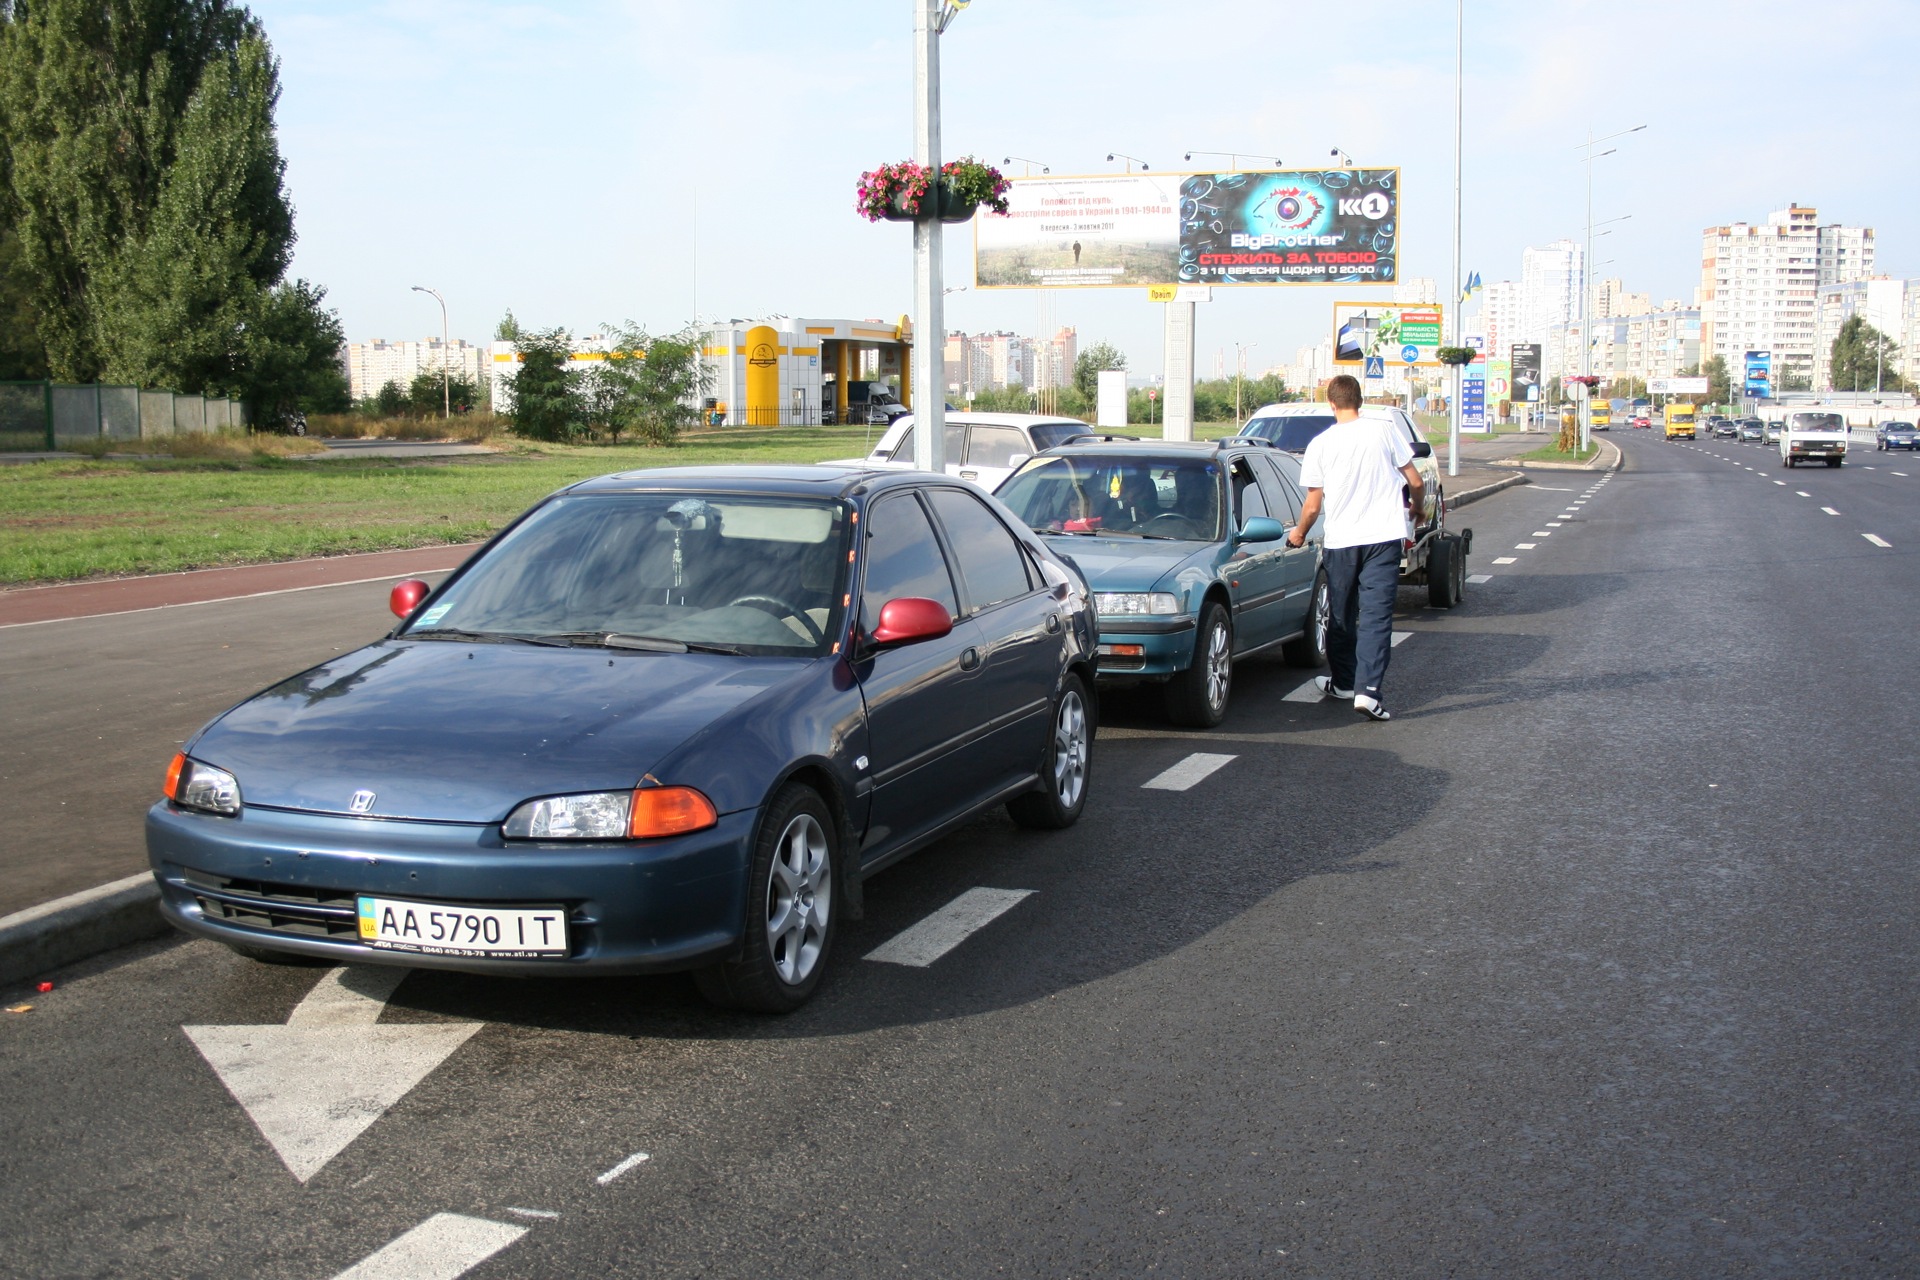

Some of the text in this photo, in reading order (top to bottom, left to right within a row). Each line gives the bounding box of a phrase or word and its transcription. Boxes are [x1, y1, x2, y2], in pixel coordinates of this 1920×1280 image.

[1200, 252, 1377, 264] СТЕЖИТЬ ЗА ТОБОЮ
[1228, 266, 1280, 275] ВЕРЕСНЯ
[1282, 266, 1325, 276] ЩОДНЯ
[1340, 266, 1375, 274] 20:00
[363, 924, 377, 933] UA
[381, 907, 556, 945] AA 5790 IT
[422, 946, 443, 954] (044)
